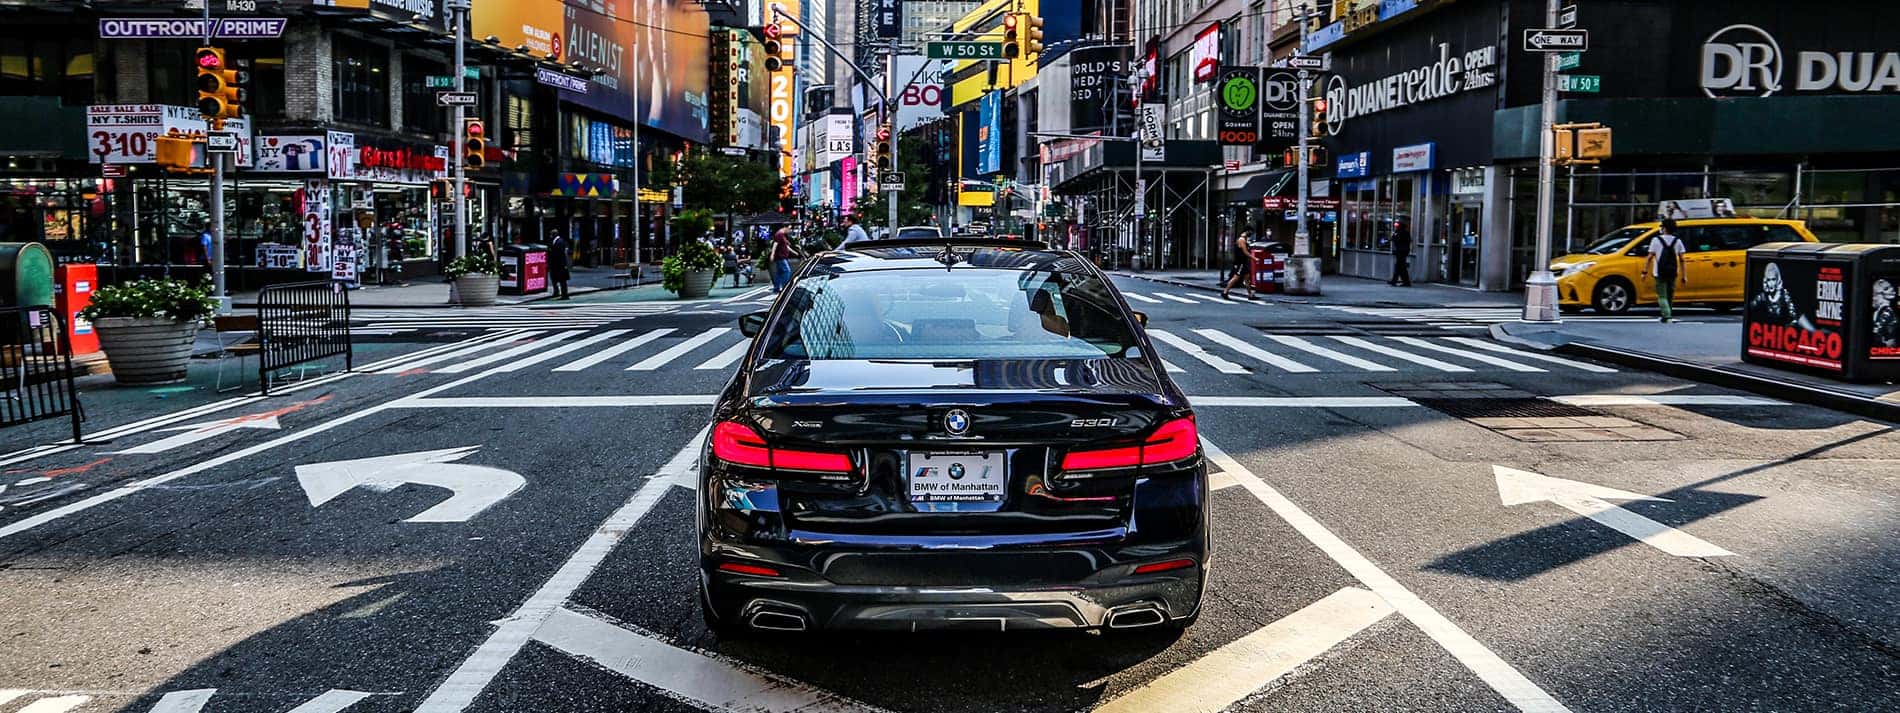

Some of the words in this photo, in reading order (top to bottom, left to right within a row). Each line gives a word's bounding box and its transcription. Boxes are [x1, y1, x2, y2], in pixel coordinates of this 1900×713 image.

[227, 0, 256, 11] M-130
[105, 21, 213, 36] OUTFRONT
[224, 21, 279, 36] PRIME
[1534, 36, 1553, 45] ONE
[1560, 36, 1579, 45] WAY
[567, 23, 624, 78] ALIENIST
[942, 45, 954, 56] W
[958, 45, 976, 56] 50
[980, 45, 994, 56] St
[1464, 46, 1495, 71] OPEN
[1071, 61, 1121, 75] ORLD'S
[1702, 42, 1782, 92] DR
[539, 70, 571, 88] OUTFRONT
[1348, 42, 1462, 118] DUANEreade
[1579, 78, 1591, 90] 50
[1265, 80, 1298, 103] DR
[139, 105, 161, 113] SALE
[1326, 87, 1347, 124] DR
[92, 115, 113, 124] NY
[113, 115, 160, 124] T.SHIRTS
[1272, 121, 1294, 129] OPEN
[92, 131, 112, 156] 3
[1220, 130, 1256, 142] FOOD
[259, 148, 280, 158] NY
[306, 213, 320, 243] 3
[1817, 281, 1843, 301] ERIKA
[1816, 301, 1843, 320] JAYNE
[1749, 322, 1843, 359] CHICAGO
[914, 483, 938, 491] BMW
[940, 482, 949, 491] of
[951, 482, 999, 491] Manhattan
